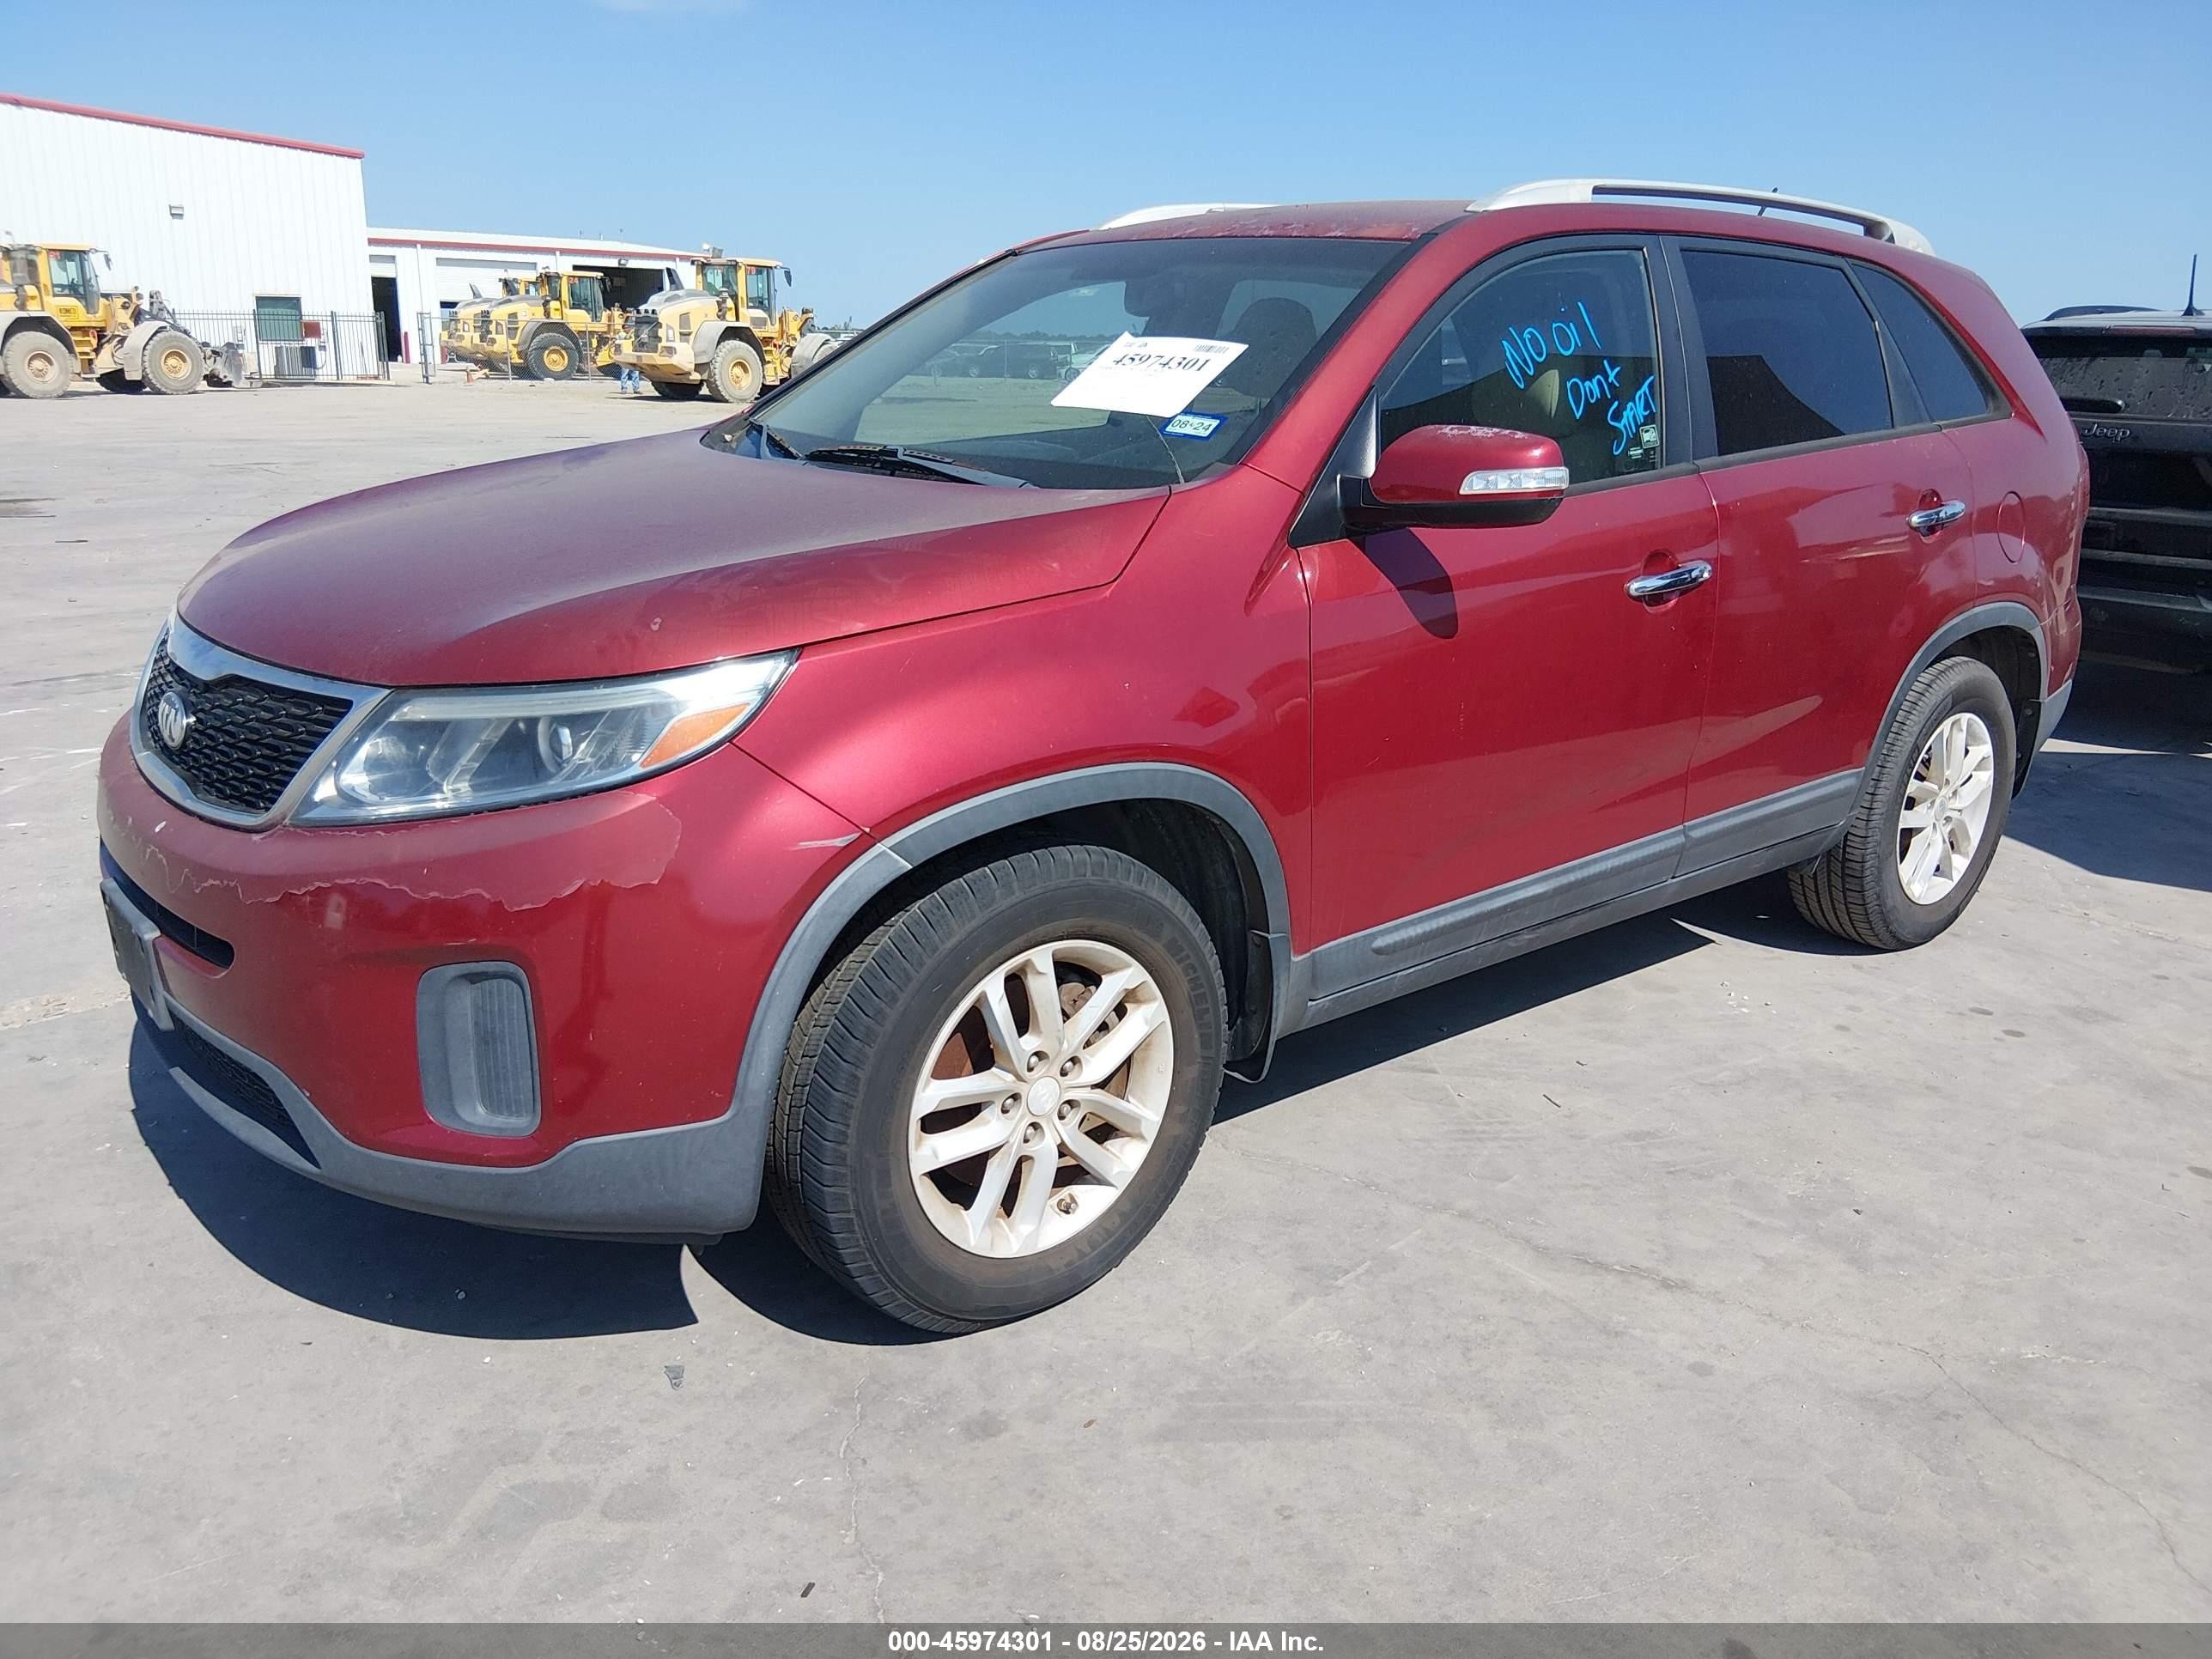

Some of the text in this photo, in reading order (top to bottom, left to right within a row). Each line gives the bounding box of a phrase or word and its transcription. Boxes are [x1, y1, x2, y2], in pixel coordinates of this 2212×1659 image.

[1112, 353, 1212, 372] 45974301
[1607, 375, 1656, 455] START
[1170, 419, 1213, 432] 08 24
[2081, 423, 2131, 441] Jeep
